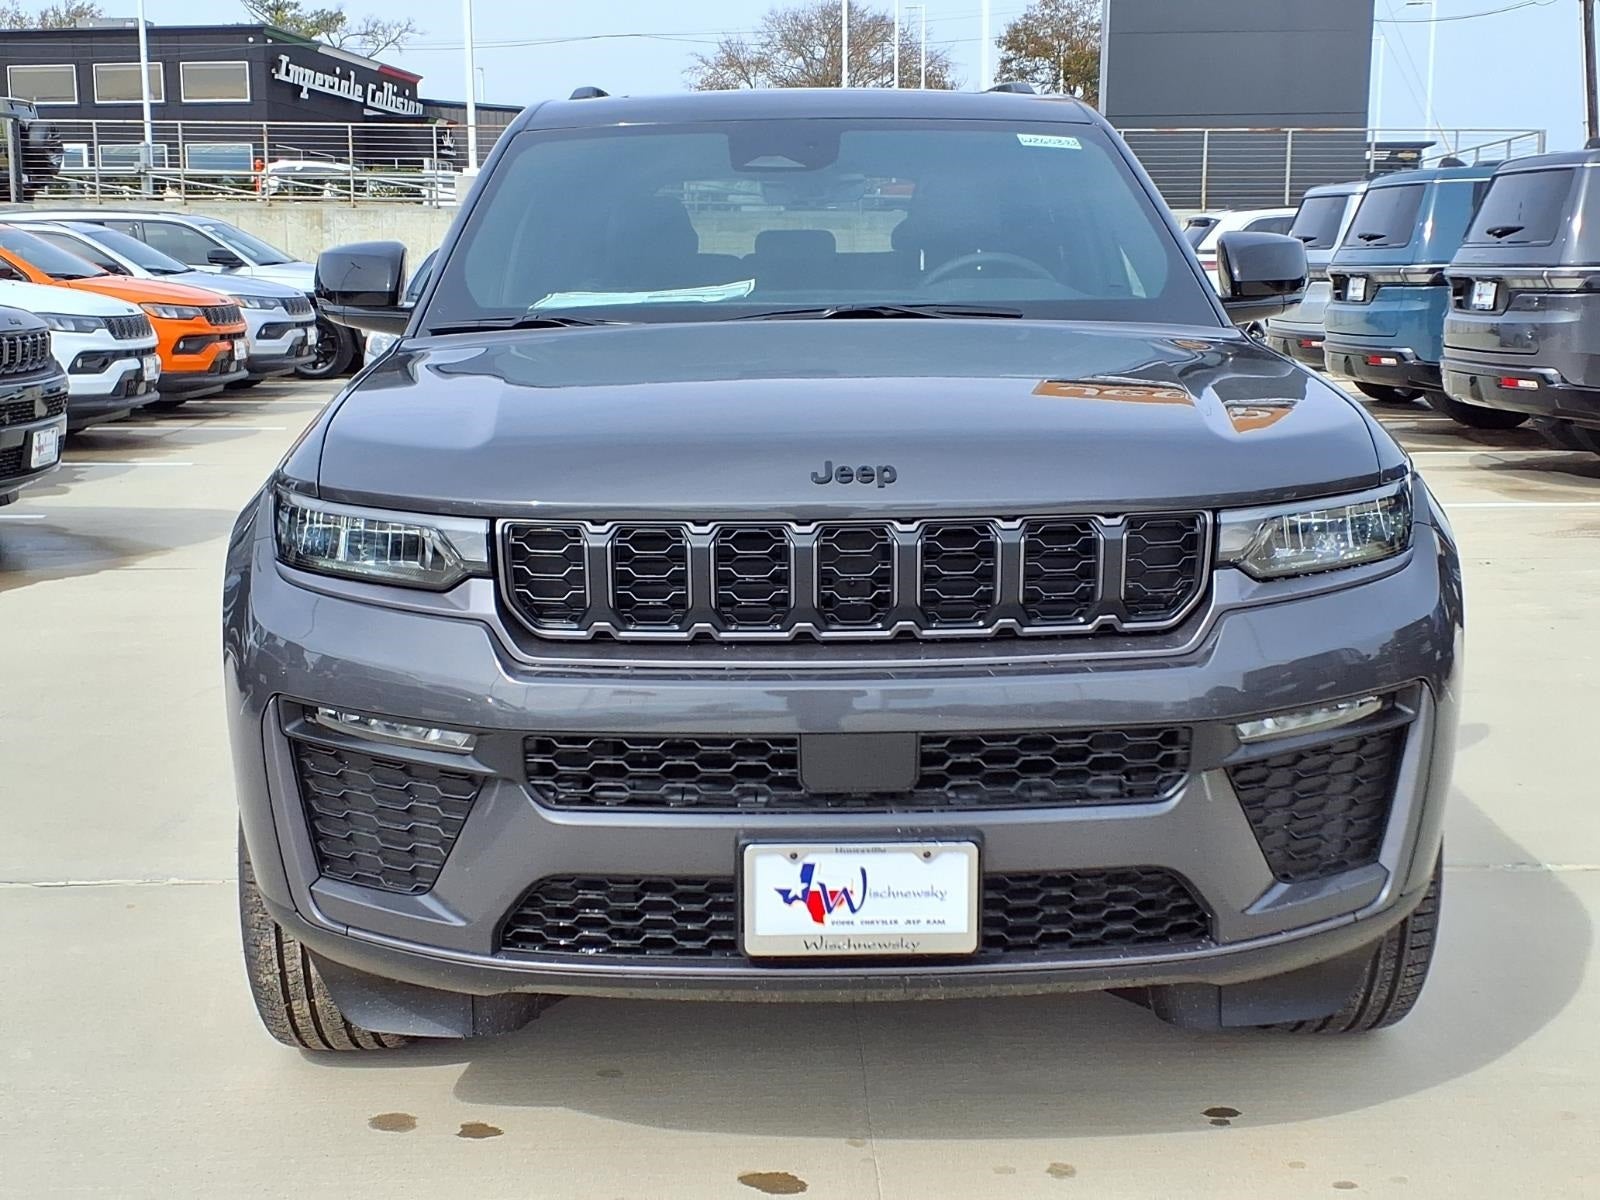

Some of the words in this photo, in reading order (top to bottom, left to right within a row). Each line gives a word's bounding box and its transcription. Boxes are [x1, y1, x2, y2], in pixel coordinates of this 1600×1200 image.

[271, 54, 364, 103] Imperiale
[367, 81, 424, 116] Collision
[810, 460, 898, 489] Jeep
[803, 935, 921, 953] Wischnewsky
